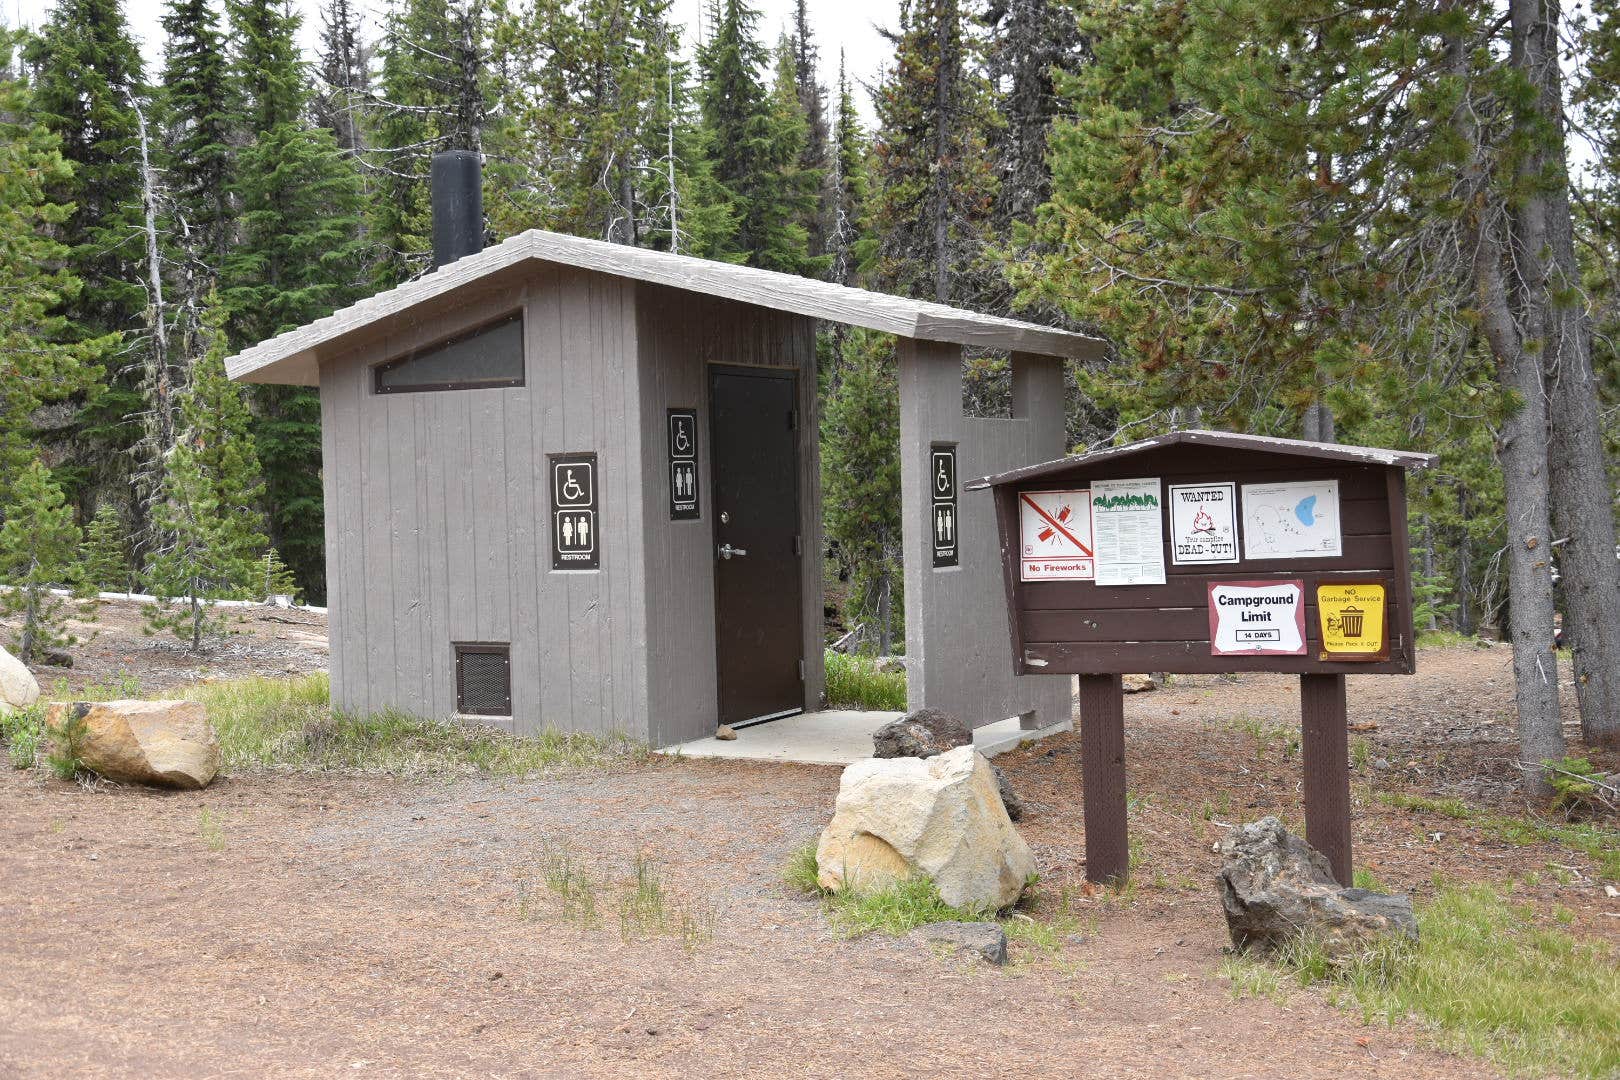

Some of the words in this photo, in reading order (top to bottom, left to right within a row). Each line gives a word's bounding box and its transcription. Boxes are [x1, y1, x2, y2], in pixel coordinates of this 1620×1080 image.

[1181, 491, 1223, 502] WANTED
[1218, 594, 1294, 607] Campground
[1241, 611, 1272, 622] Limit
